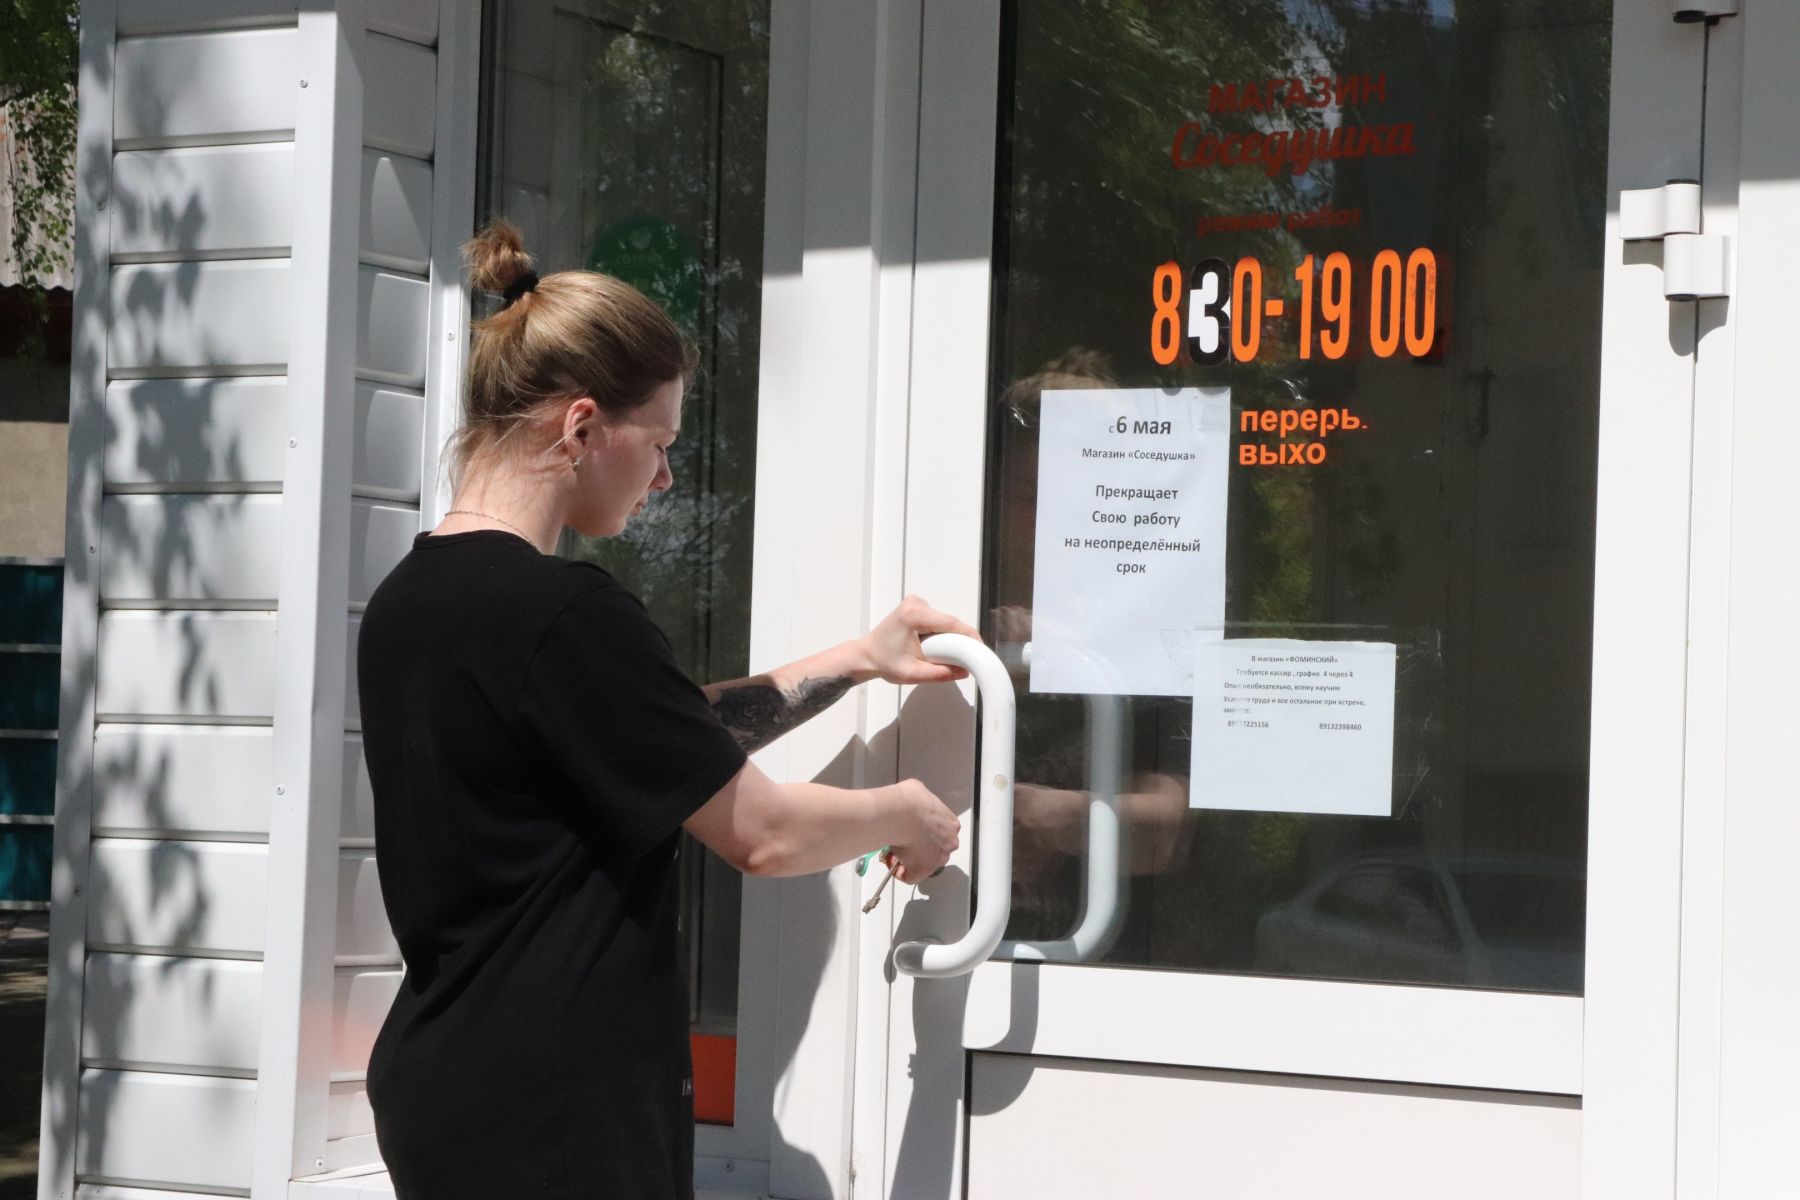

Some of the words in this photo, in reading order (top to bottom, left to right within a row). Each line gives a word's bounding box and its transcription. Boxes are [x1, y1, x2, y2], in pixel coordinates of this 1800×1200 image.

[1207, 71, 1387, 113] МАГАЗИН
[1171, 121, 1417, 176] Соседушка
[1133, 420, 1172, 435] мая
[1082, 448, 1126, 459] Магазин
[1128, 449, 1196, 462] «Соседушка»
[1239, 442, 1327, 466] выхо
[1095, 484, 1179, 501] Прекращает
[1092, 510, 1127, 524] Свою
[1134, 512, 1181, 528] работу
[1064, 537, 1080, 548] на
[1084, 538, 1201, 553] неопределённый
[1116, 562, 1147, 576] срок
[1285, 655, 1339, 663] «ФОМИНСКИЙ»
[1329, 671, 1348, 679] через
[1294, 684, 1314, 692] всему
[1251, 697, 1271, 705] труда
